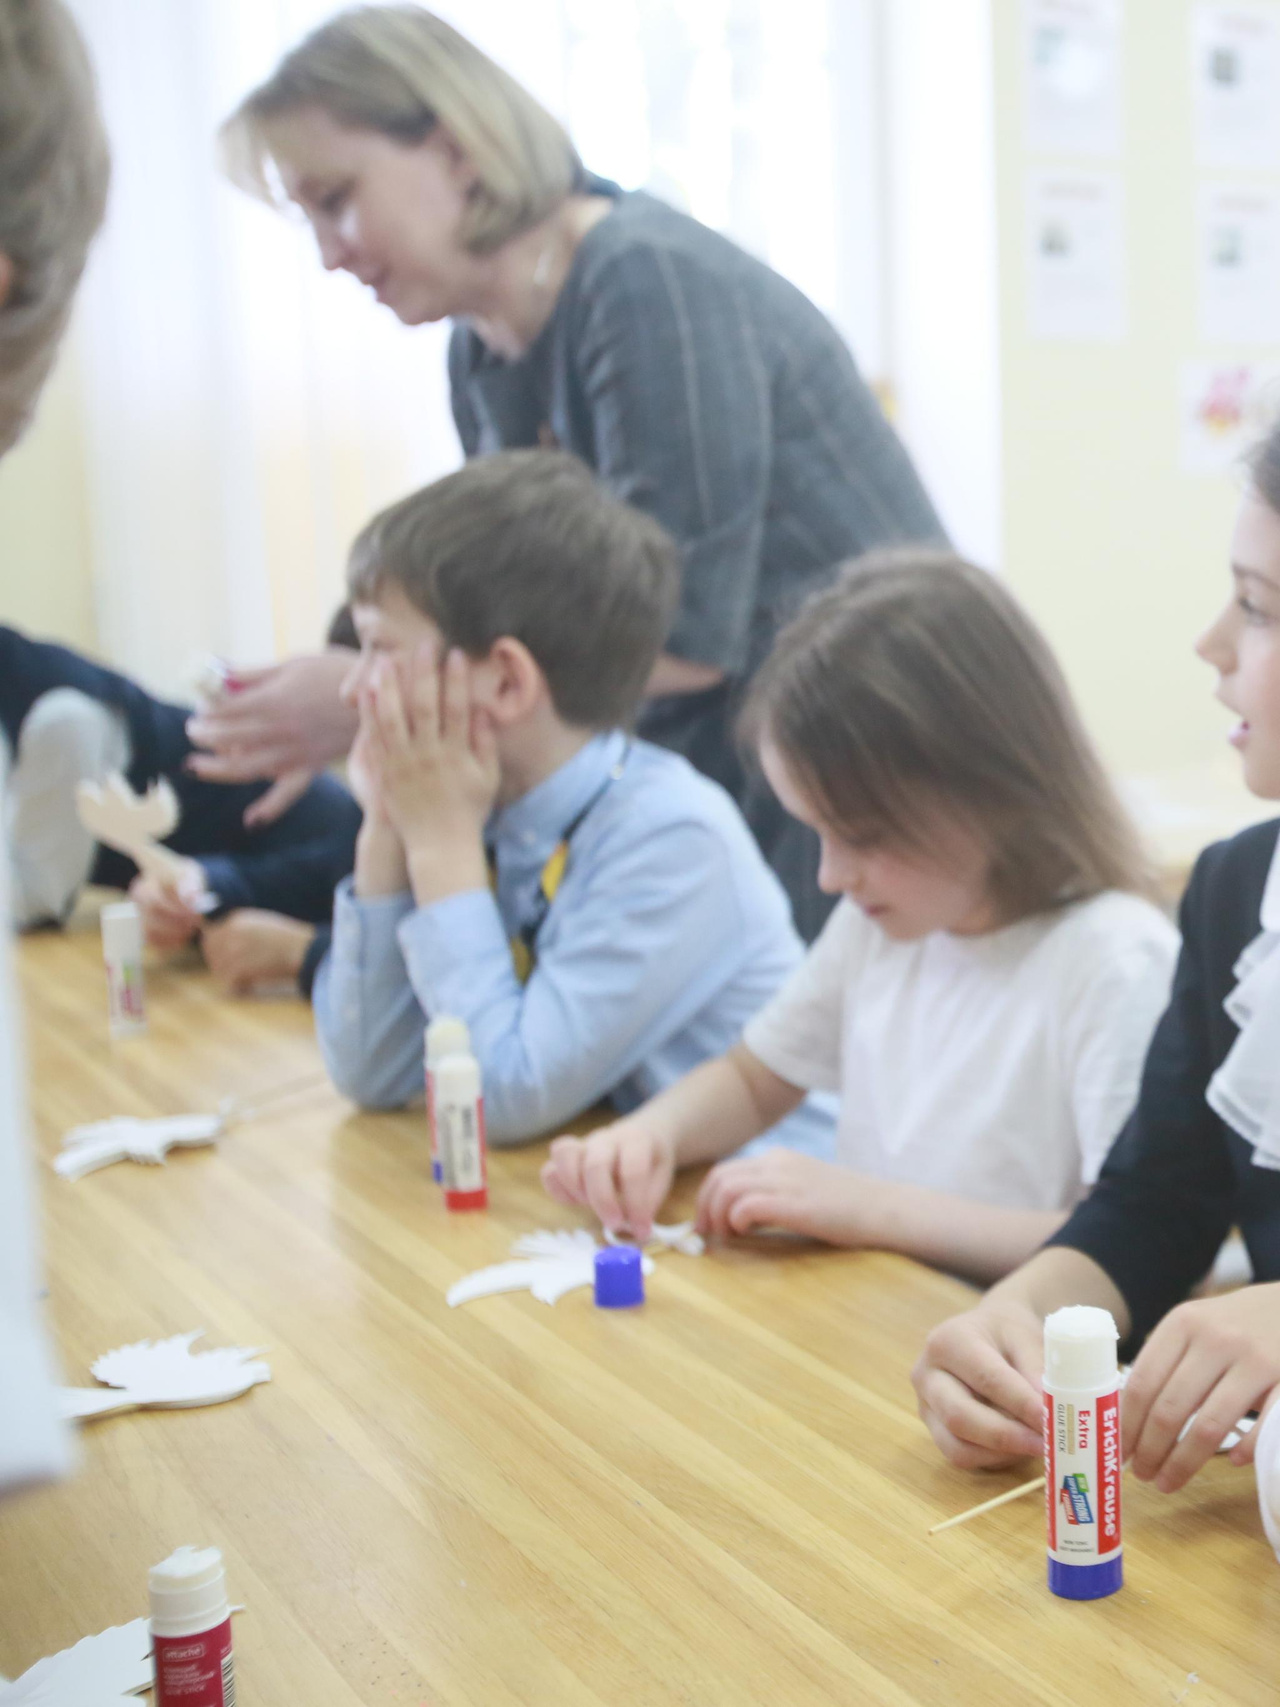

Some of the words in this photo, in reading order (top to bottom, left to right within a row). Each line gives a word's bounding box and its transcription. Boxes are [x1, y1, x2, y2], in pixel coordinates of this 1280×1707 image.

[1057, 1404, 1066, 1426] GLUE
[1058, 1429, 1066, 1453] STICK
[1078, 1410, 1091, 1449] Extra
[1103, 1407, 1118, 1537] ErichKrause
[1072, 1494, 1091, 1522] STRONG
